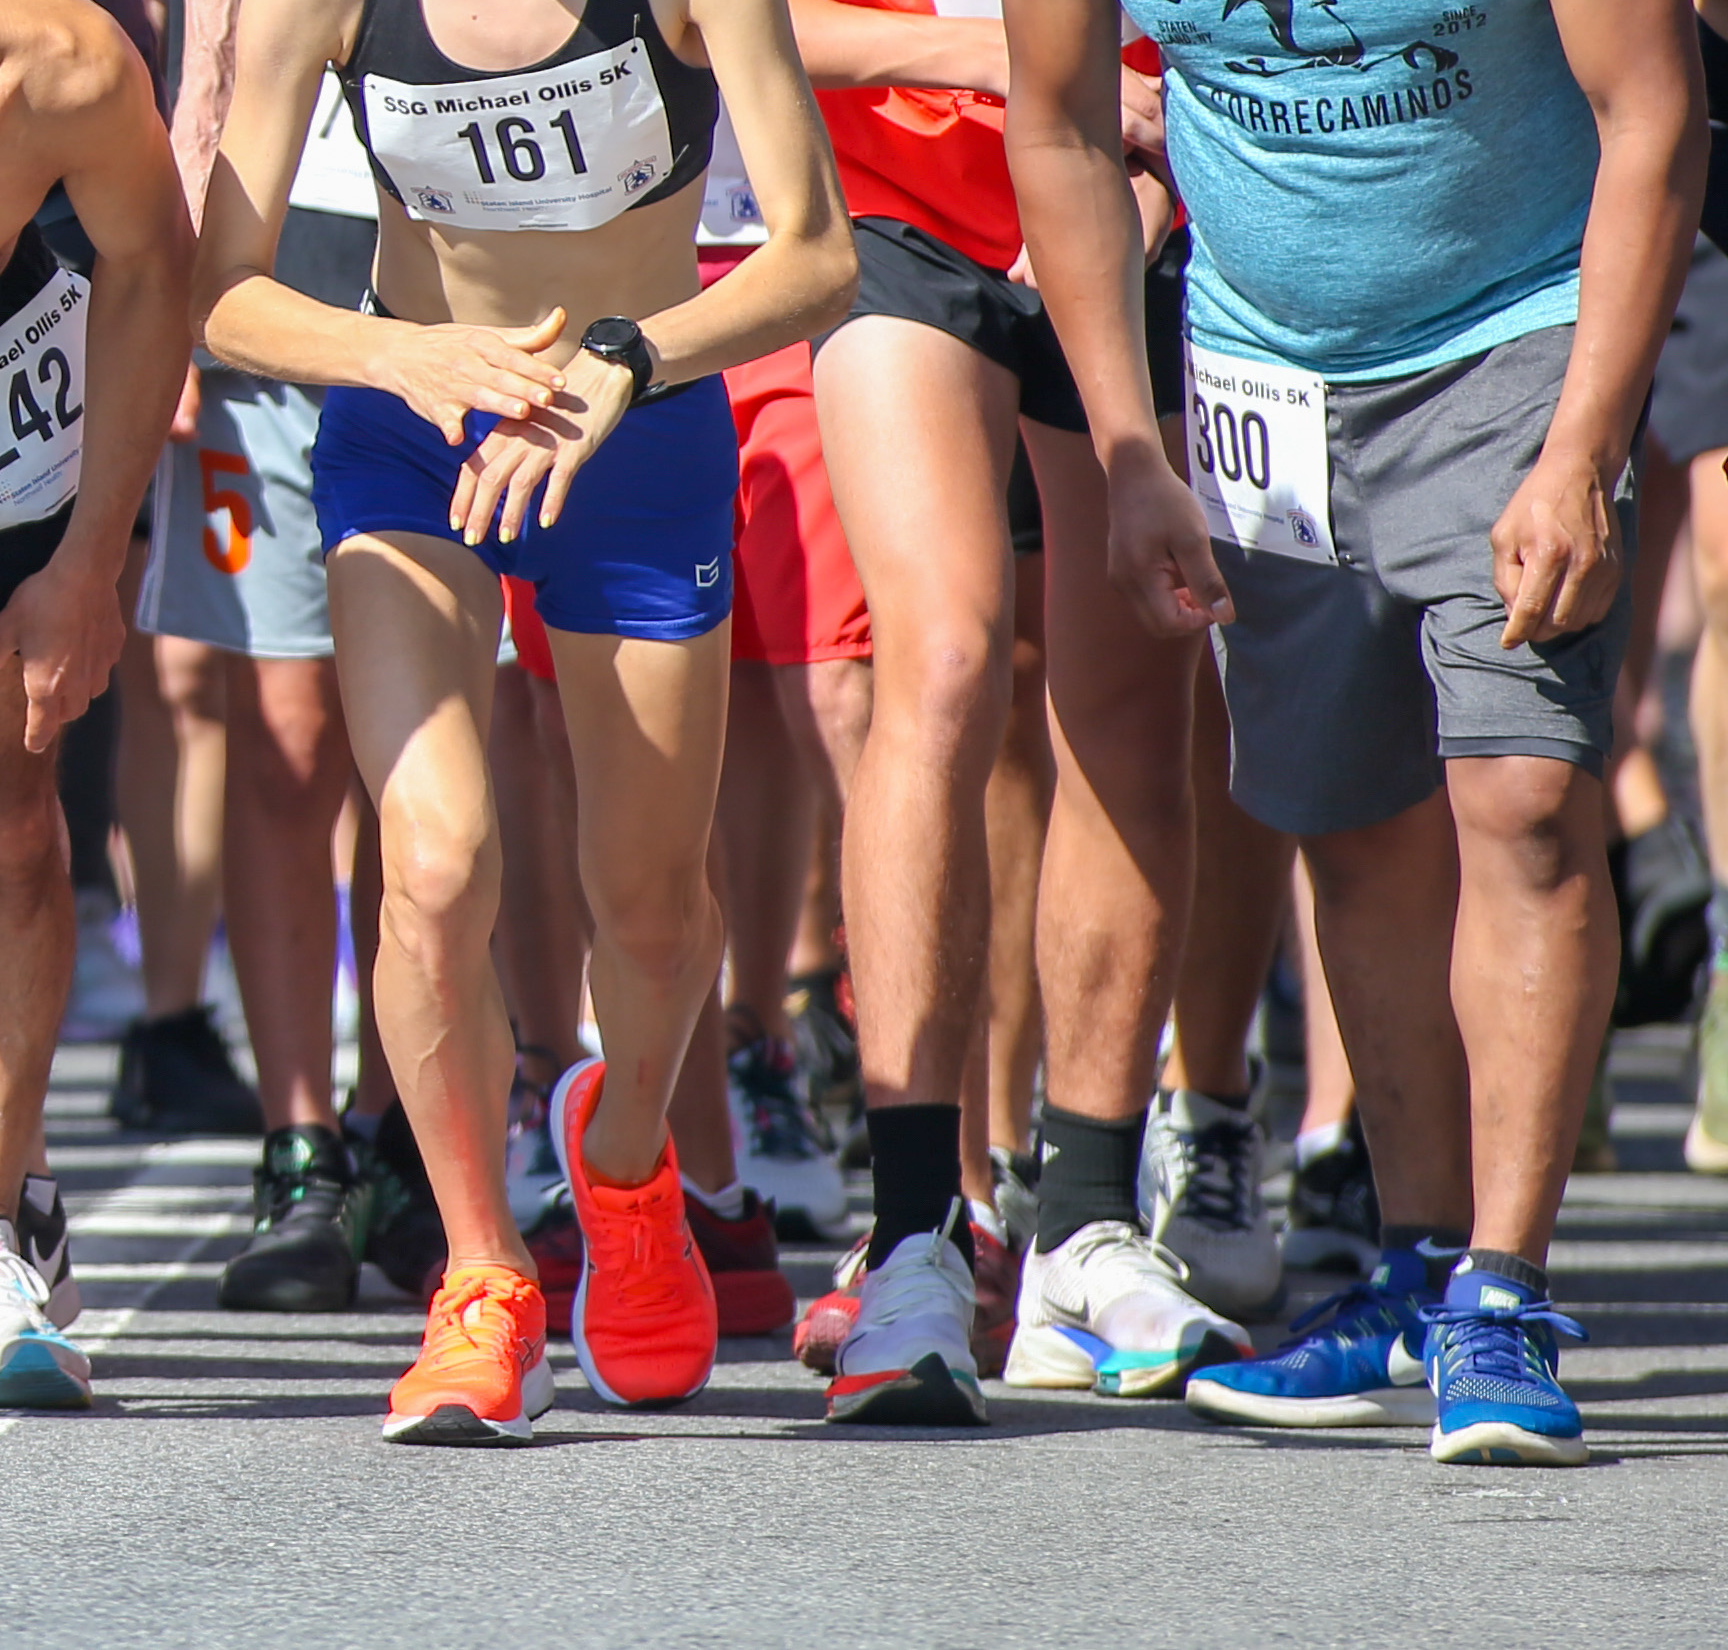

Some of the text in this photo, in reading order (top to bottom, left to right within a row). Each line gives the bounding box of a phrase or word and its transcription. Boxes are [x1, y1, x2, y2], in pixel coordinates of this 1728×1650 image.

[1432, 13, 1487, 37] 2012
[1442, 5, 1479, 23] SINCE
[383, 60, 634, 116] SSG Michael Ollis 5K
[457, 108, 589, 185] 161
[534, 195, 577, 206] University
[578, 186, 613, 201] Hospital
[24, 308, 62, 345] Ollis
[58, 283, 83, 313] 5K
[1241, 379, 1282, 402] Ollis
[1286, 388, 1312, 408] 5K
[1193, 392, 1271, 491] 300
[199, 446, 254, 577] 5
